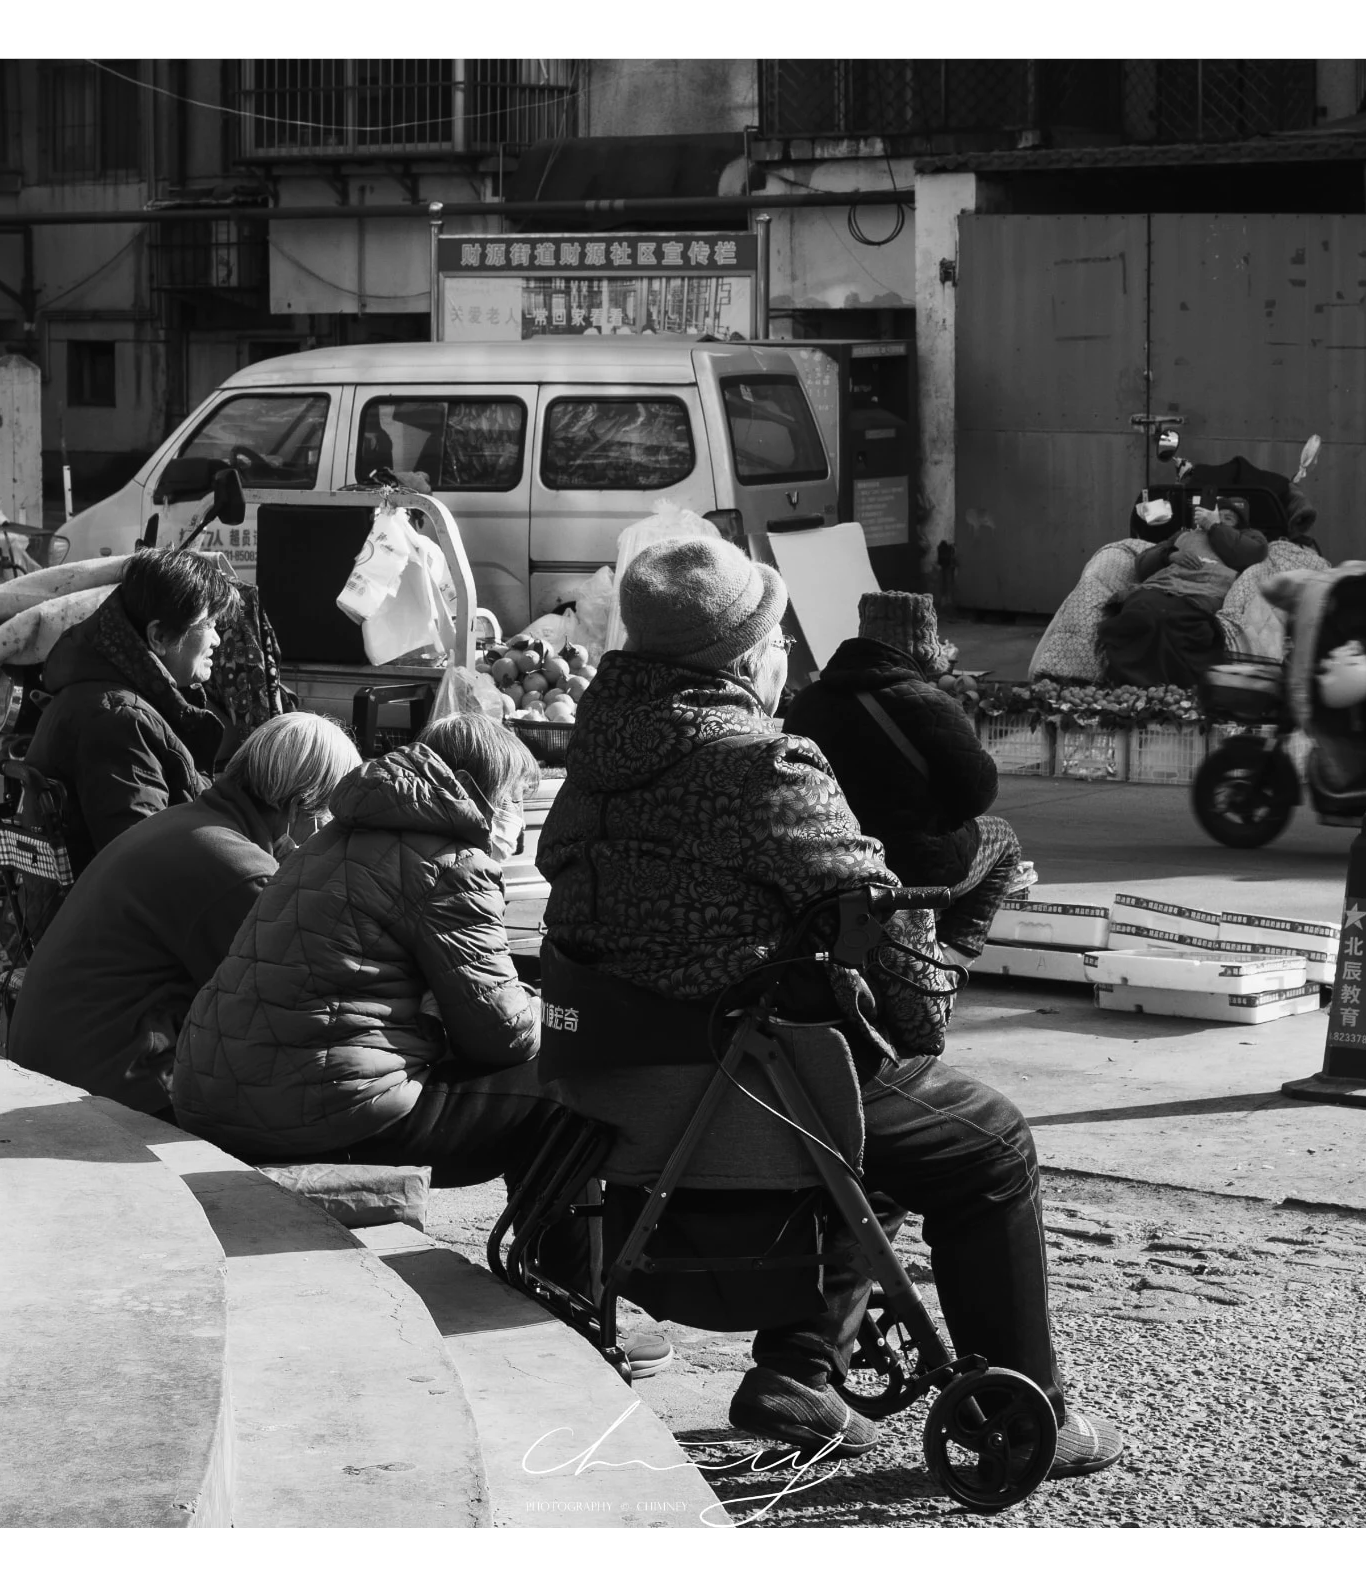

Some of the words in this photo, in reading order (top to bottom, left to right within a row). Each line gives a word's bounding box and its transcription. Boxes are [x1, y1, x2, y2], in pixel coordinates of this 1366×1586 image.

[460, 240, 738, 266] 财源街道财源社区宣传栏
[1339, 936, 1364, 1028] 北辰教育
